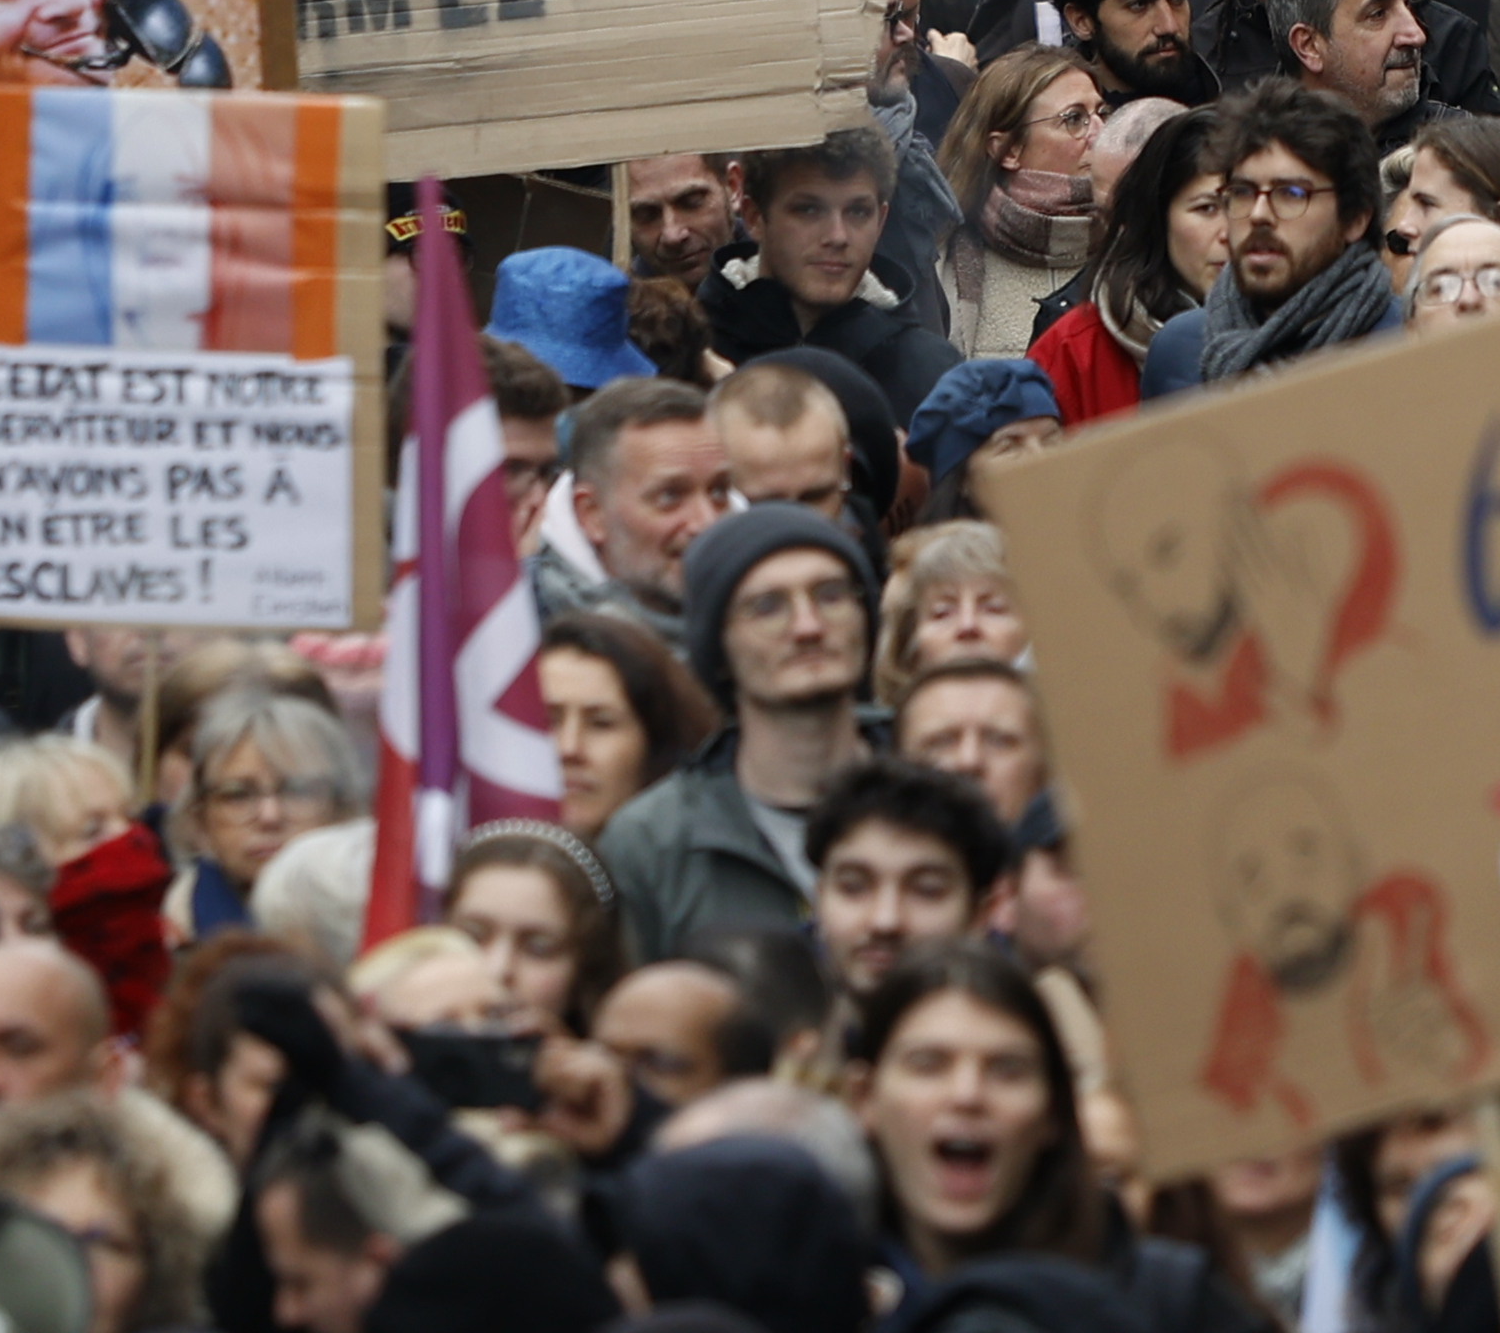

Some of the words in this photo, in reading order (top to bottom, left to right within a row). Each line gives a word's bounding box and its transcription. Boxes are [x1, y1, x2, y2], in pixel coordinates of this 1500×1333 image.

[121, 366, 190, 405] EST
[194, 419, 236, 450] ET
[166, 463, 246, 503] PAS
[169, 514, 250, 552] LES
